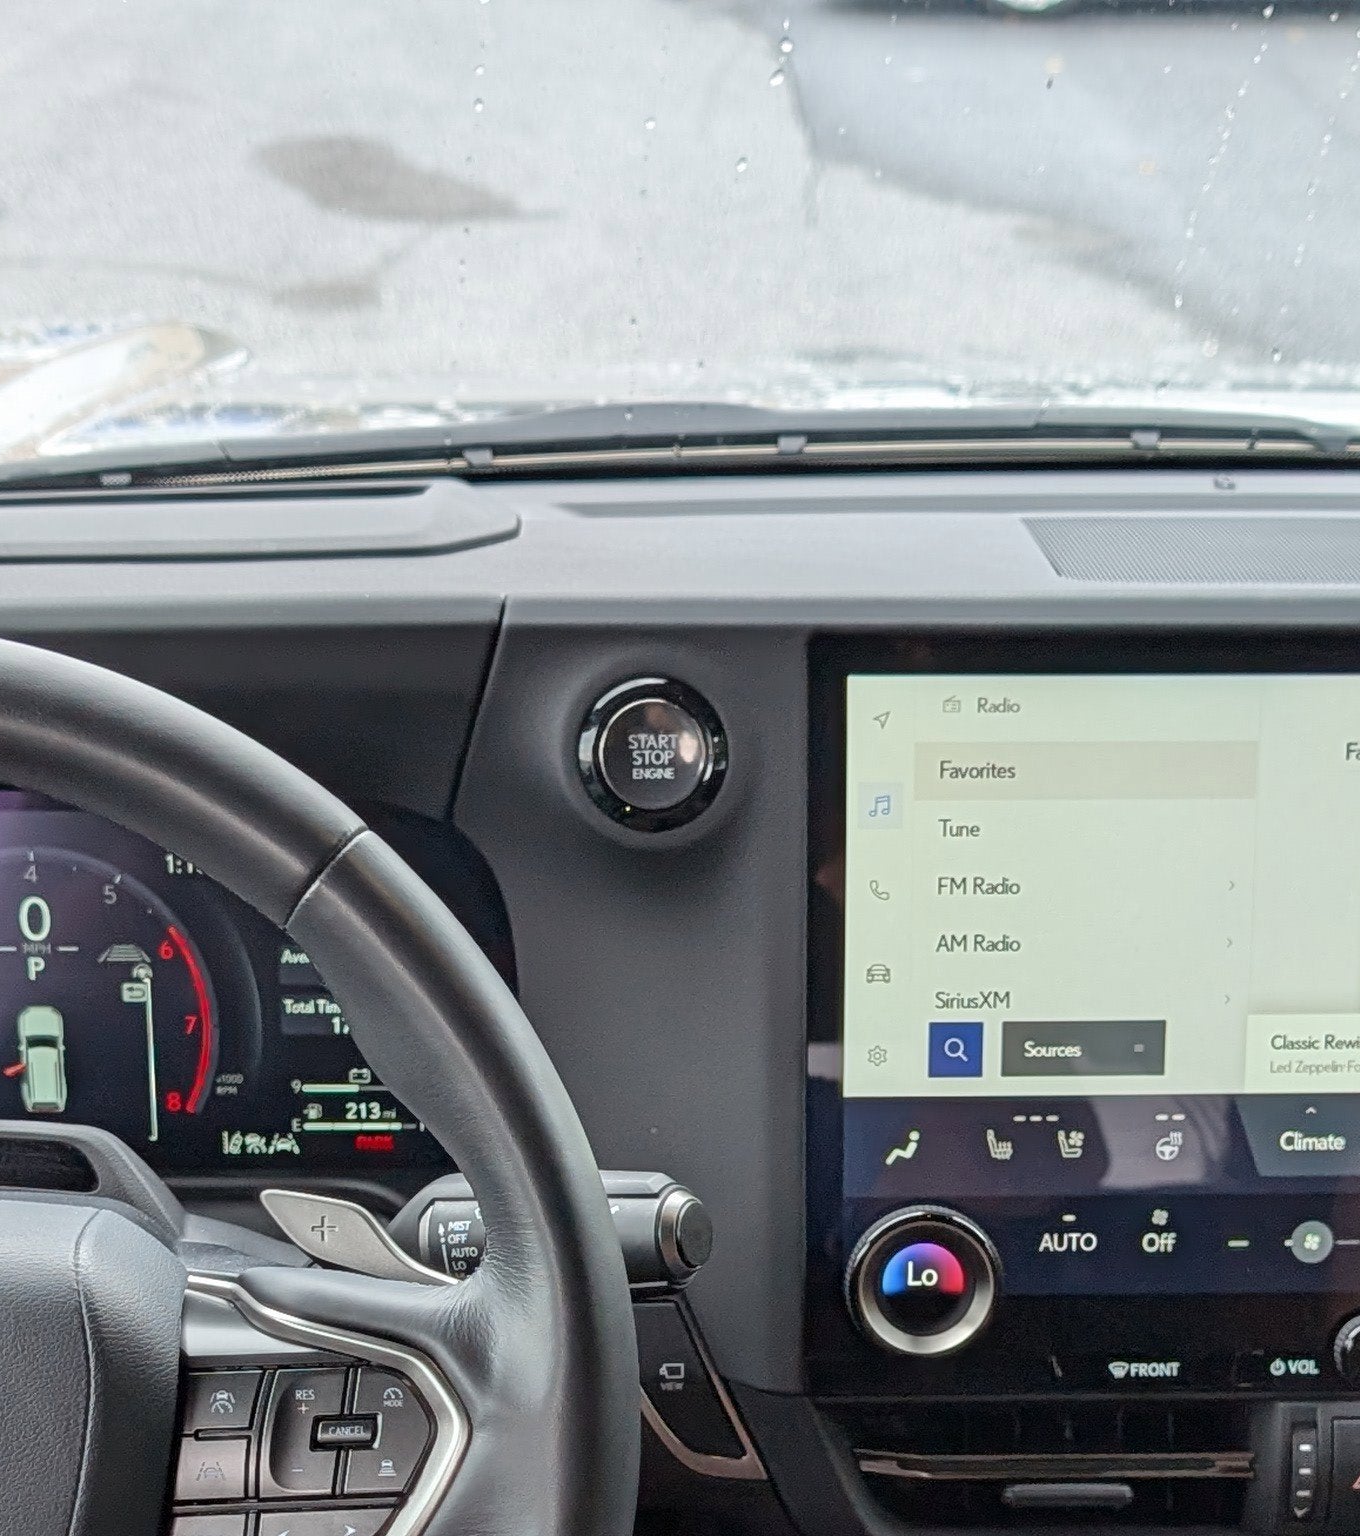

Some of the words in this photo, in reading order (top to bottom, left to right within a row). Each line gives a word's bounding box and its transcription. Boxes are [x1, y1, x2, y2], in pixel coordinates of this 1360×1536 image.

[976, 697, 1022, 714] Radio
[628, 734, 678, 750] START
[632, 750, 675, 765] STOP
[632, 768, 675, 780] ENGINE
[938, 760, 1016, 780] Favorites
[938, 819, 981, 838] Tune
[165, 854, 202, 874] 1:1
[23, 865, 38, 884] 4
[103, 885, 118, 905] 5
[937, 877, 968, 896] FM
[973, 876, 1022, 896] Radio
[18, 895, 52, 942] 0
[159, 941, 175, 961] 6
[936, 934, 969, 953] AM
[973, 933, 1022, 953] Radio
[27, 955, 46, 981] P
[282, 998, 316, 1015] Total
[934, 990, 1011, 1010] SiriusXM
[185, 1015, 197, 1034] 7
[1023, 1041, 1082, 1058] Sources
[1270, 1034, 1320, 1050] Classic
[1269, 1060, 1292, 1074] Led
[166, 1091, 183, 1112] 8
[345, 1101, 382, 1120] 213
[291, 1117, 303, 1133] E
[1279, 1131, 1346, 1153] Climate
[447, 1220, 472, 1232] MIST
[447, 1233, 468, 1245] OFF
[1039, 1233, 1099, 1253] AUTO
[1142, 1231, 1178, 1254] Off
[450, 1246, 478, 1259] AUTO
[451, 1261, 467, 1272] LO
[906, 1260, 939, 1288] Lo
[1129, 1361, 1181, 1378] FRONT
[1288, 1359, 1320, 1375] VOL
[295, 1389, 315, 1401] RES
[328, 1426, 365, 1437] CANCEL
